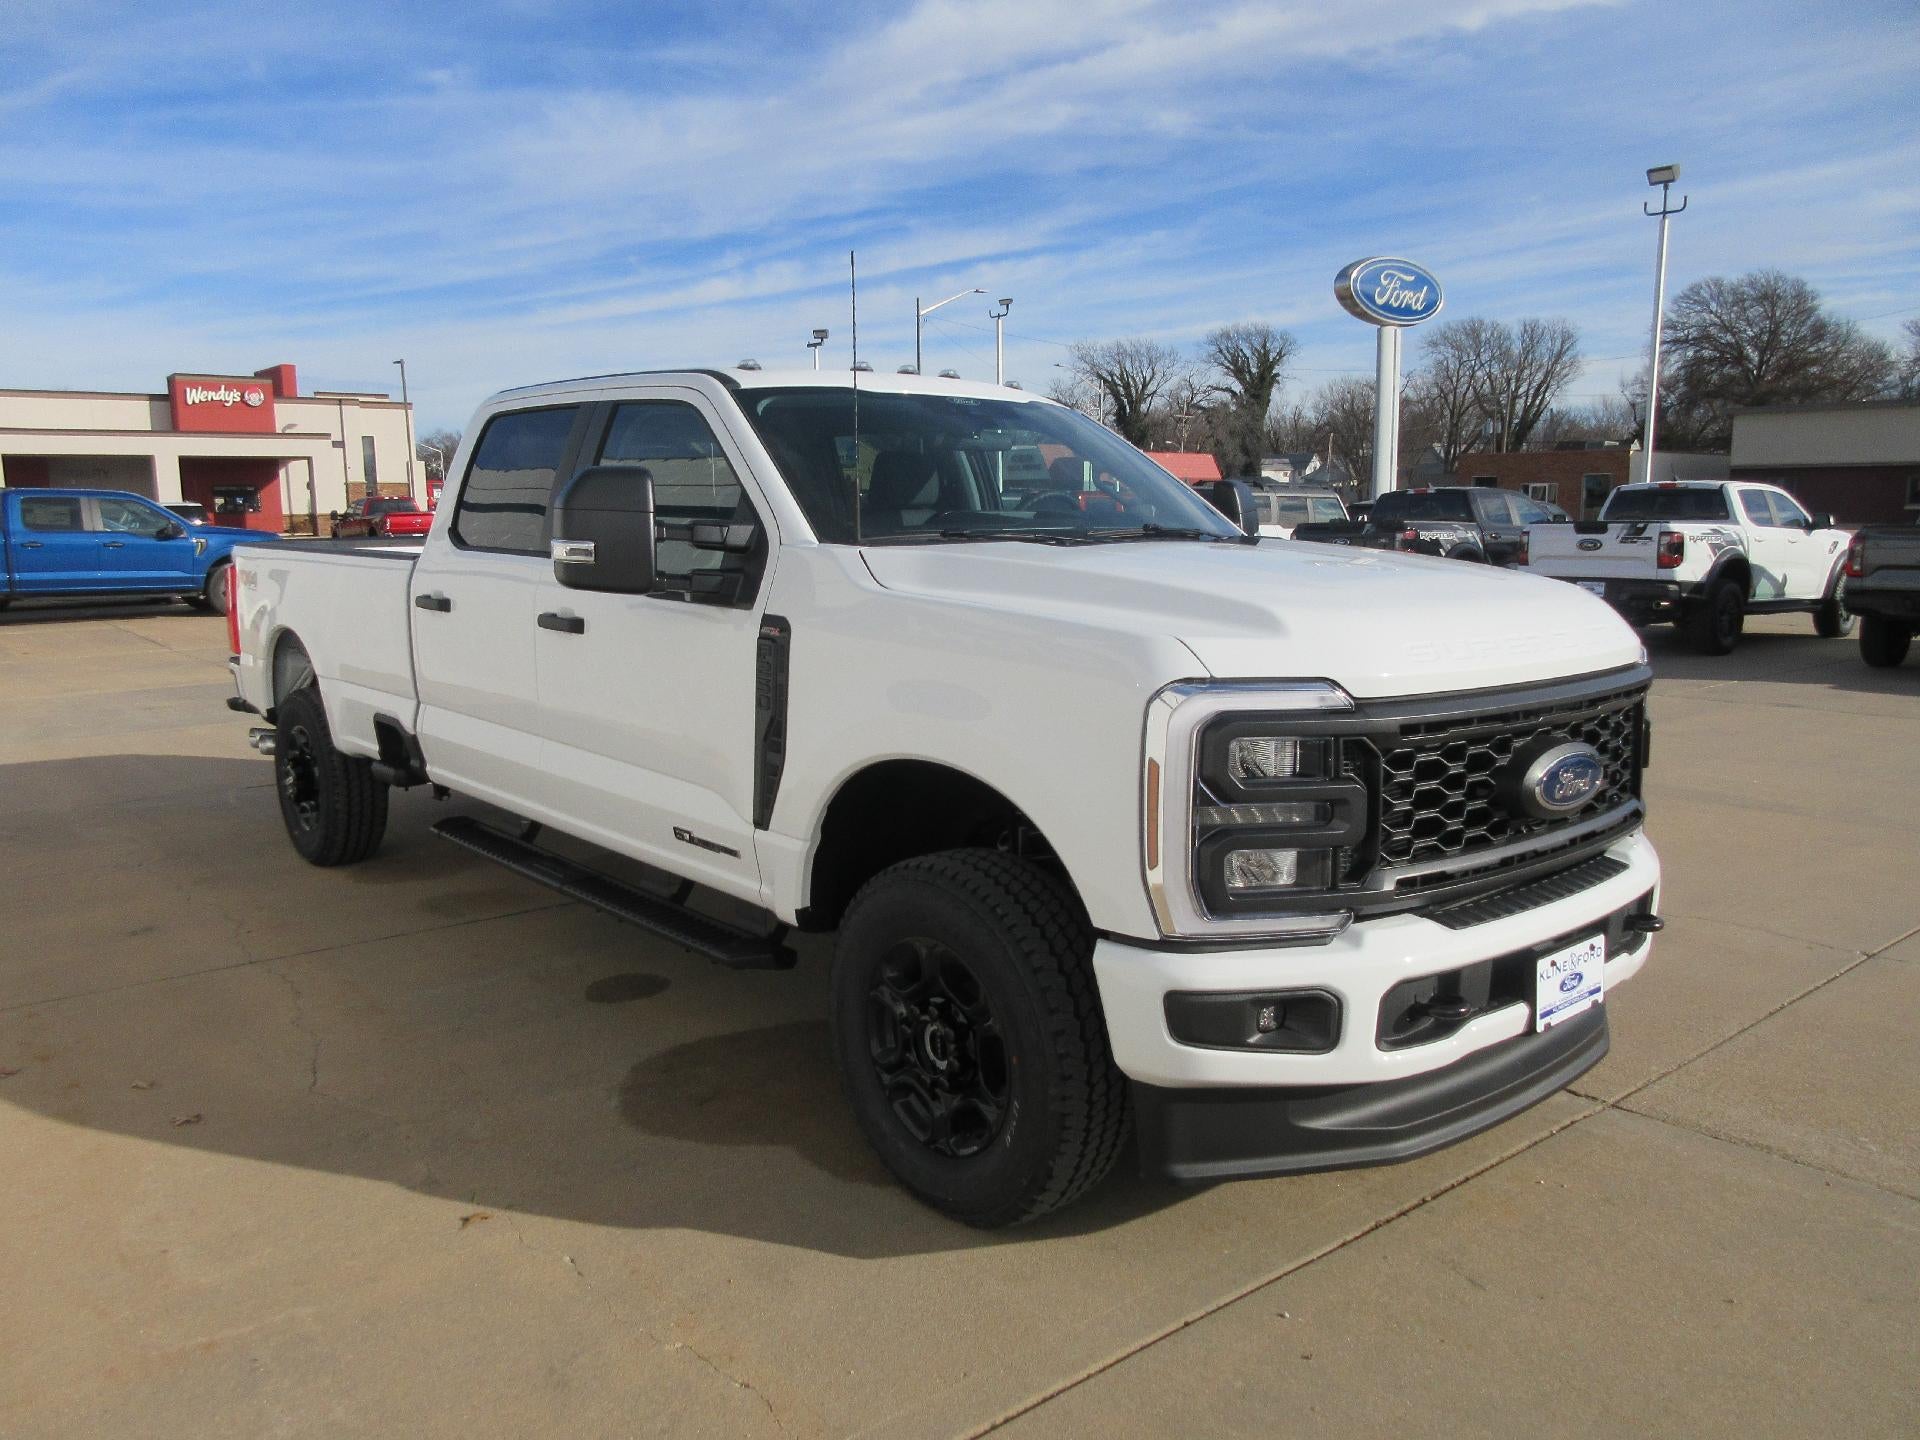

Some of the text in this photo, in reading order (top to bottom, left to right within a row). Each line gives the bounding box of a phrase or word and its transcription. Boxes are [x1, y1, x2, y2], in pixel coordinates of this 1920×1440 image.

[1374, 270, 1428, 311] Ford
[186, 385, 240, 407] Wendy's
[1419, 531, 1457, 541] RAPTOR
[1688, 535, 1722, 543] RAPTOR
[1555, 767, 1592, 799] Ford
[1561, 974, 1581, 991] Ford
